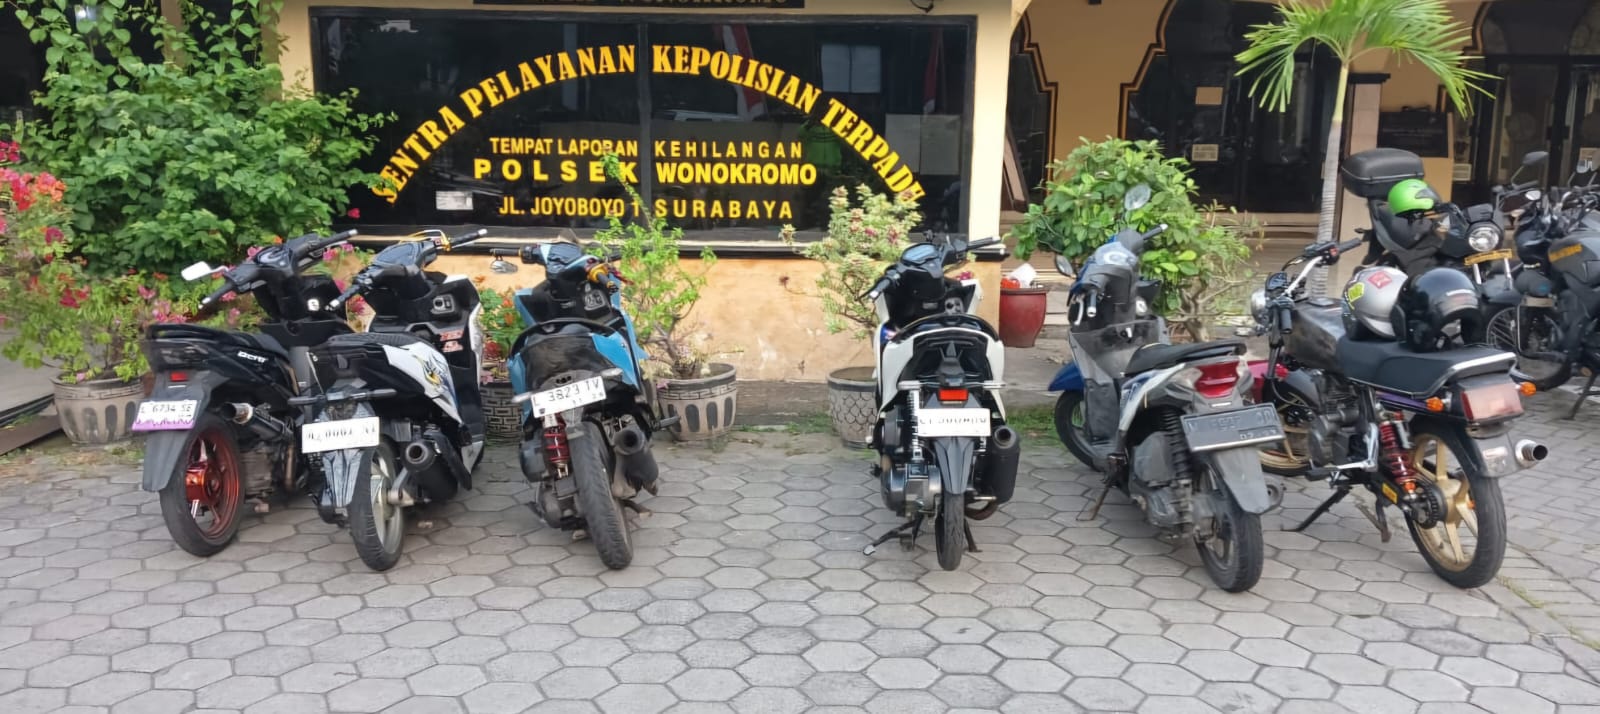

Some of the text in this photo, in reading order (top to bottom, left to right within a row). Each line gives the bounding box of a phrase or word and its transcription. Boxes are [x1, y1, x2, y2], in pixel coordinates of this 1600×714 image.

[459, 44, 636, 118] PELAYANAN
[652, 44, 821, 114] KEPOLISIAN
[490, 137, 802, 159] TEMPAT LAPORAN KEHILANGAN
[474, 158, 817, 185] POLSEK WONOKROMO
[499, 196, 526, 215] JL.
[531, 197, 625, 217] JOYOBOYO
[655, 198, 793, 219] SURABAYA
[548, 384, 580, 402] 3823
